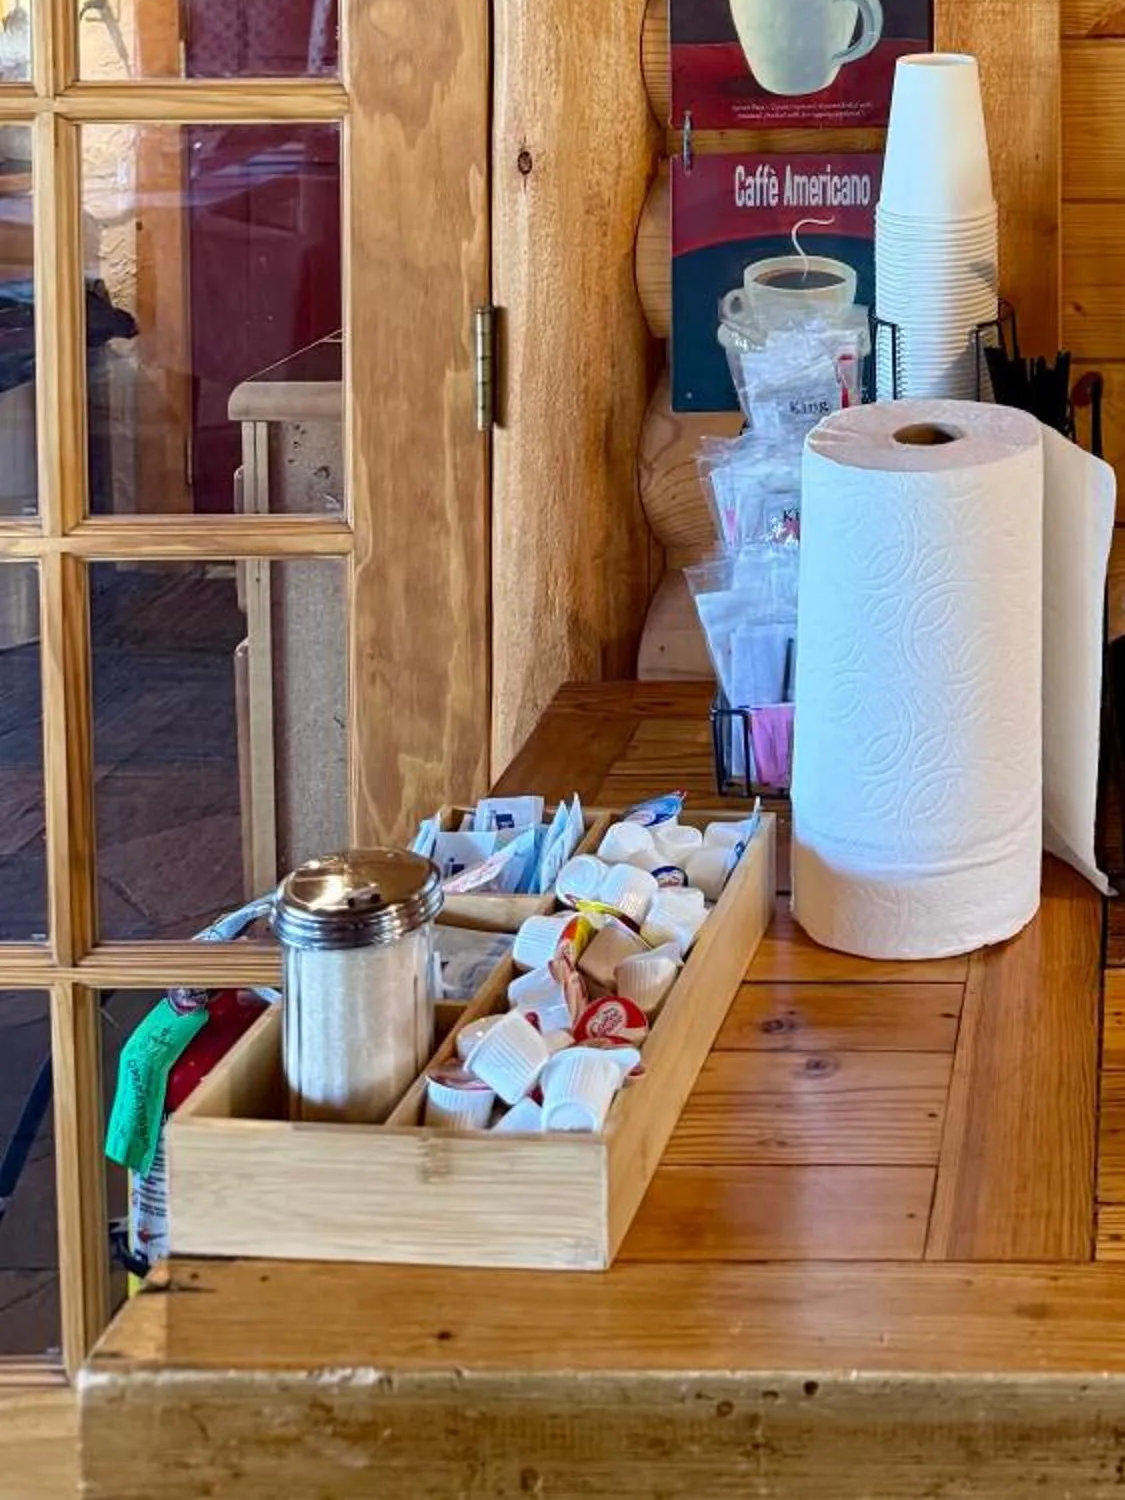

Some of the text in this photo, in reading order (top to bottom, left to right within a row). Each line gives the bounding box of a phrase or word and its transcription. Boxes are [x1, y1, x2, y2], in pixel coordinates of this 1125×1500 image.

[735, 164, 871, 207] Caffè Americano
[789, 400, 830, 414] King
